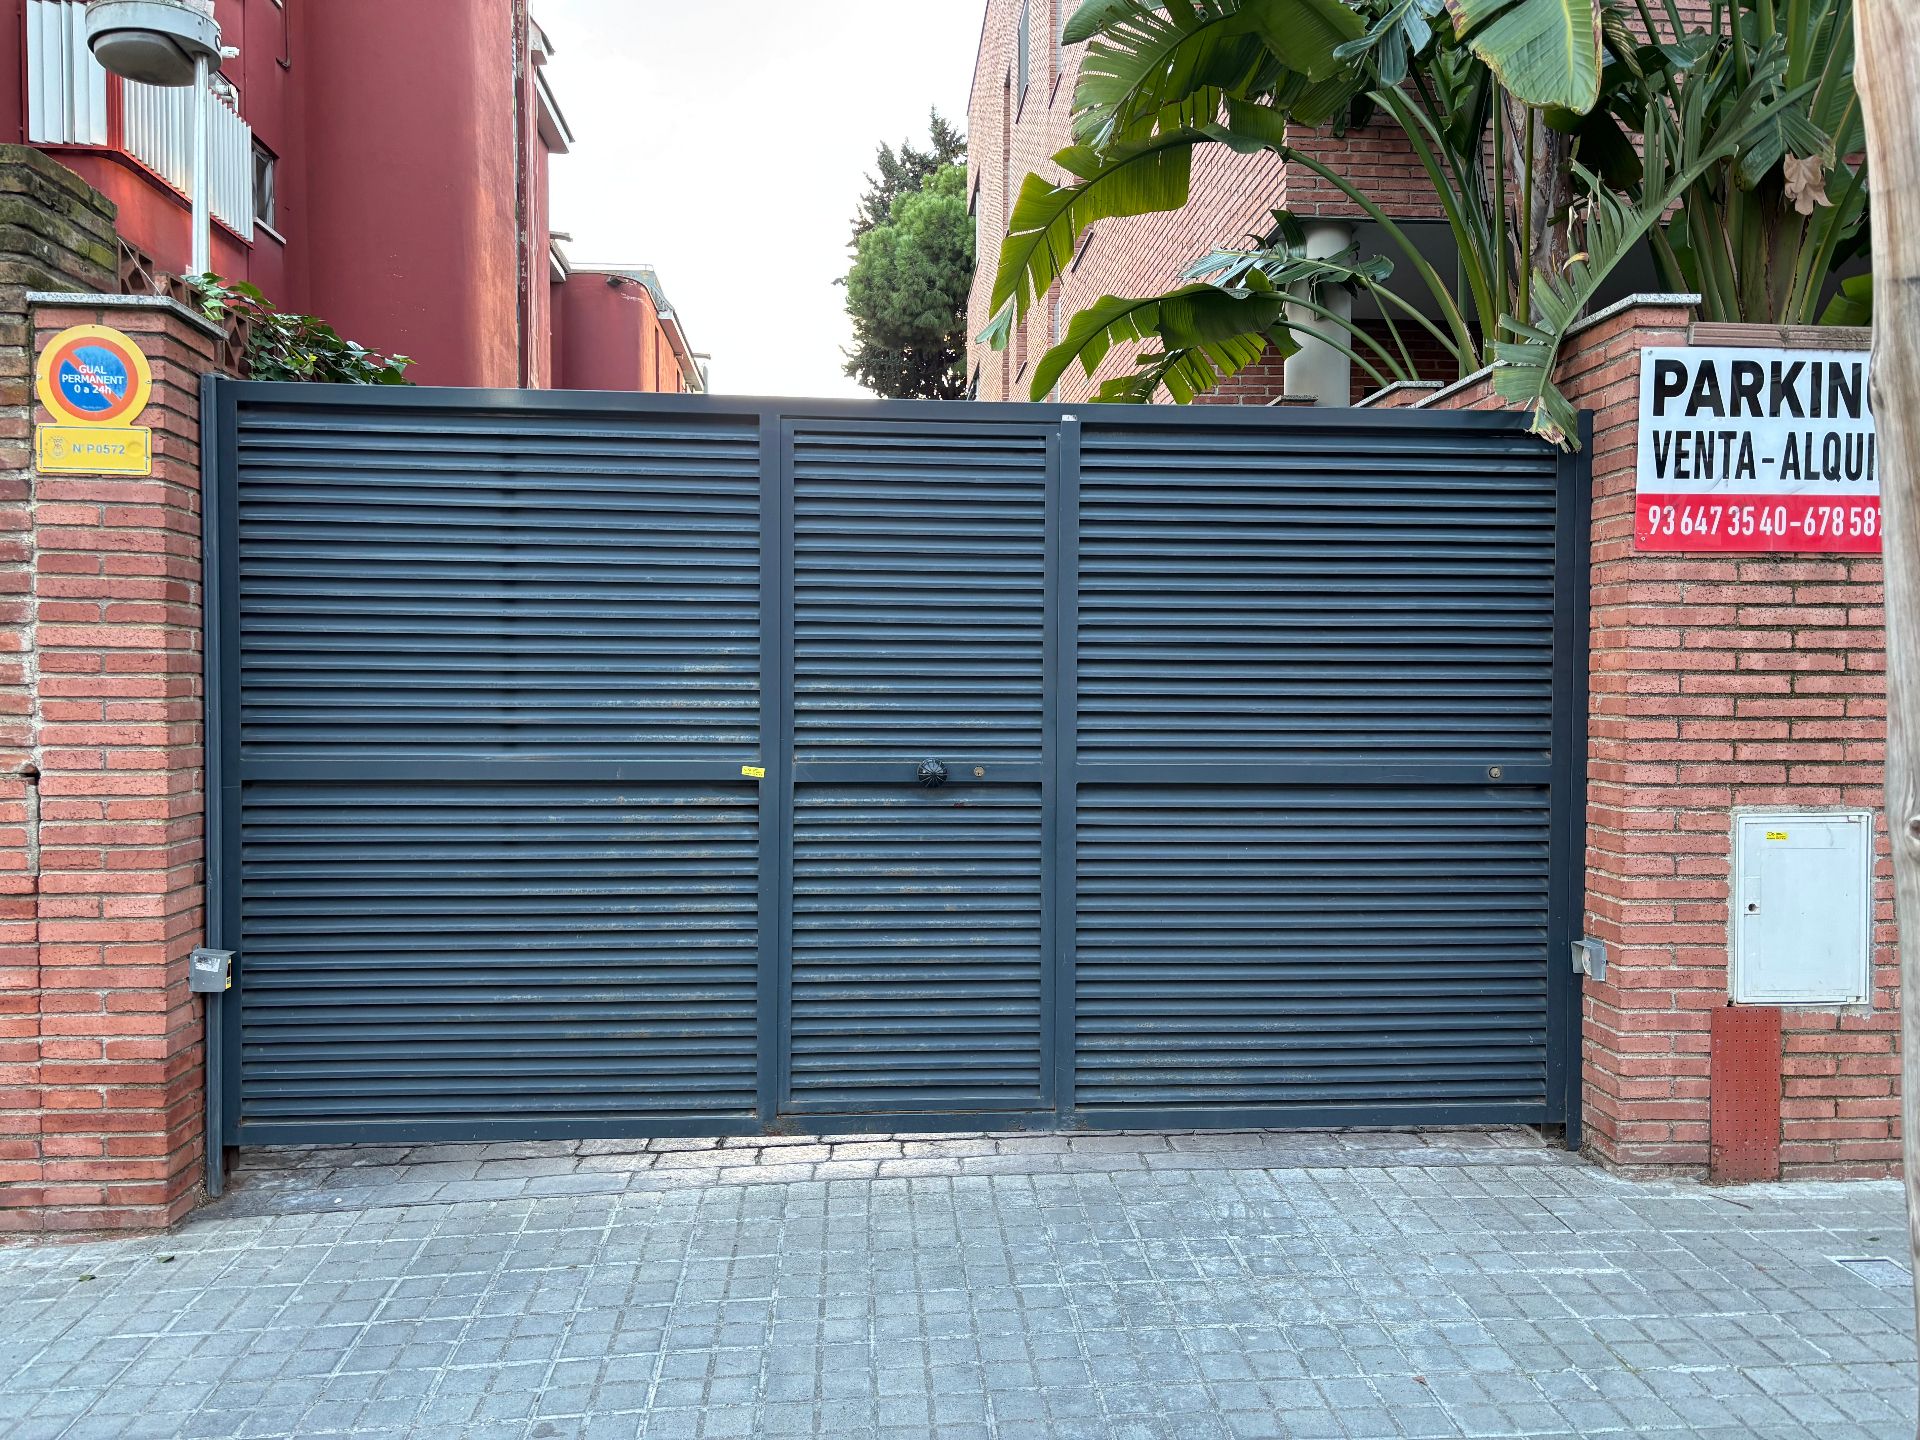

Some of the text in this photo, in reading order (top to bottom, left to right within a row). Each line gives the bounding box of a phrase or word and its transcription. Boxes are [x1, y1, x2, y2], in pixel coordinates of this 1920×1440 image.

[79, 365, 107, 375] GUAL
[62, 374, 124, 385] PERMANENT
[73, 384, 112, 394] 0 a 24h
[1652, 359, 1873, 419] PARKIN
[1648, 505, 1675, 535] 93
[1680, 505, 1723, 535] 647
[1727, 505, 1755, 536] 35
